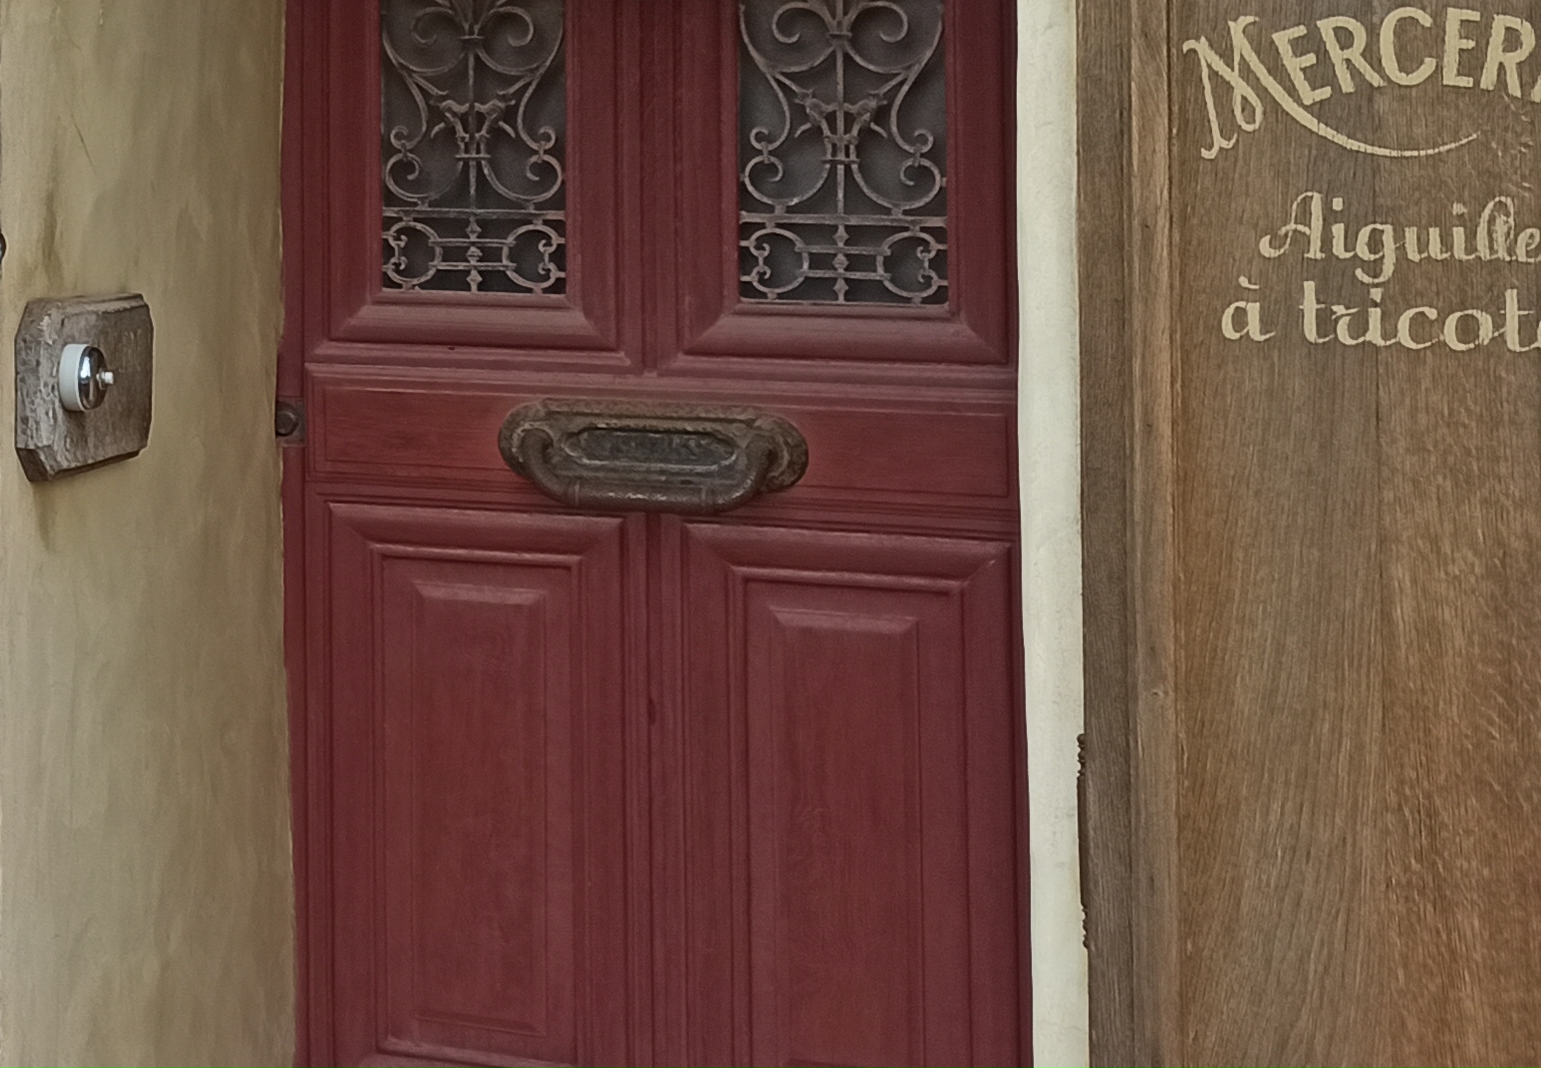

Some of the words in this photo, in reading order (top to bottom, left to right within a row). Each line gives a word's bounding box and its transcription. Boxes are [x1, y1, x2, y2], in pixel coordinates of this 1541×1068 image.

[1182, 6, 1541, 160] MERCER
[1221, 276, 1276, 343] à
[1299, 280, 1541, 352] tricot
